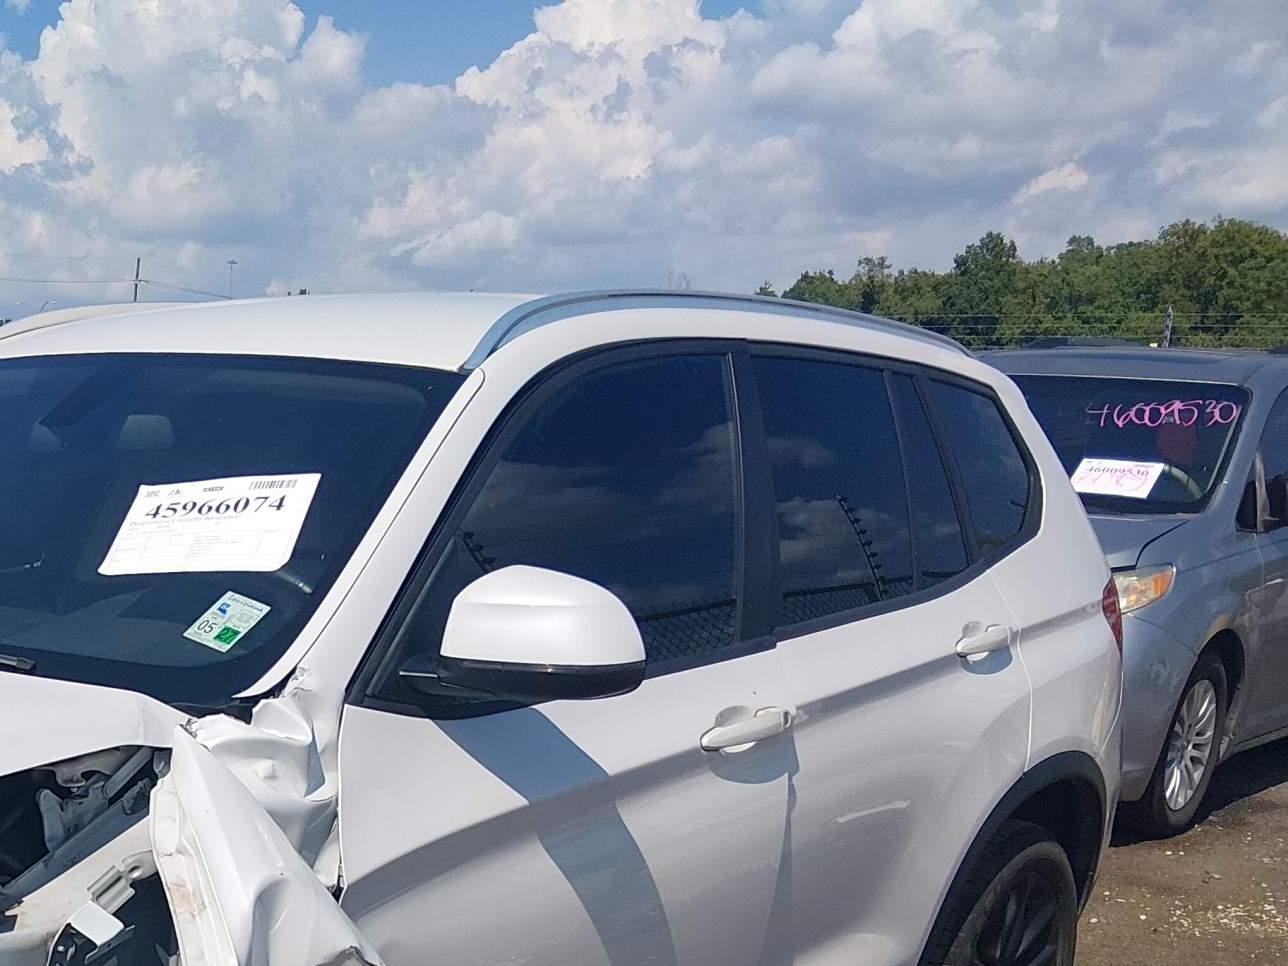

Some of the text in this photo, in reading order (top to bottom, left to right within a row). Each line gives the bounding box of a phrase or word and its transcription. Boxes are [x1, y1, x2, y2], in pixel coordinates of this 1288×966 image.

[1086, 400, 1237, 428] 46009530
[145, 494, 287, 519] 45966074
[197, 619, 218, 634] 05
[217, 627, 239, 643] 27
